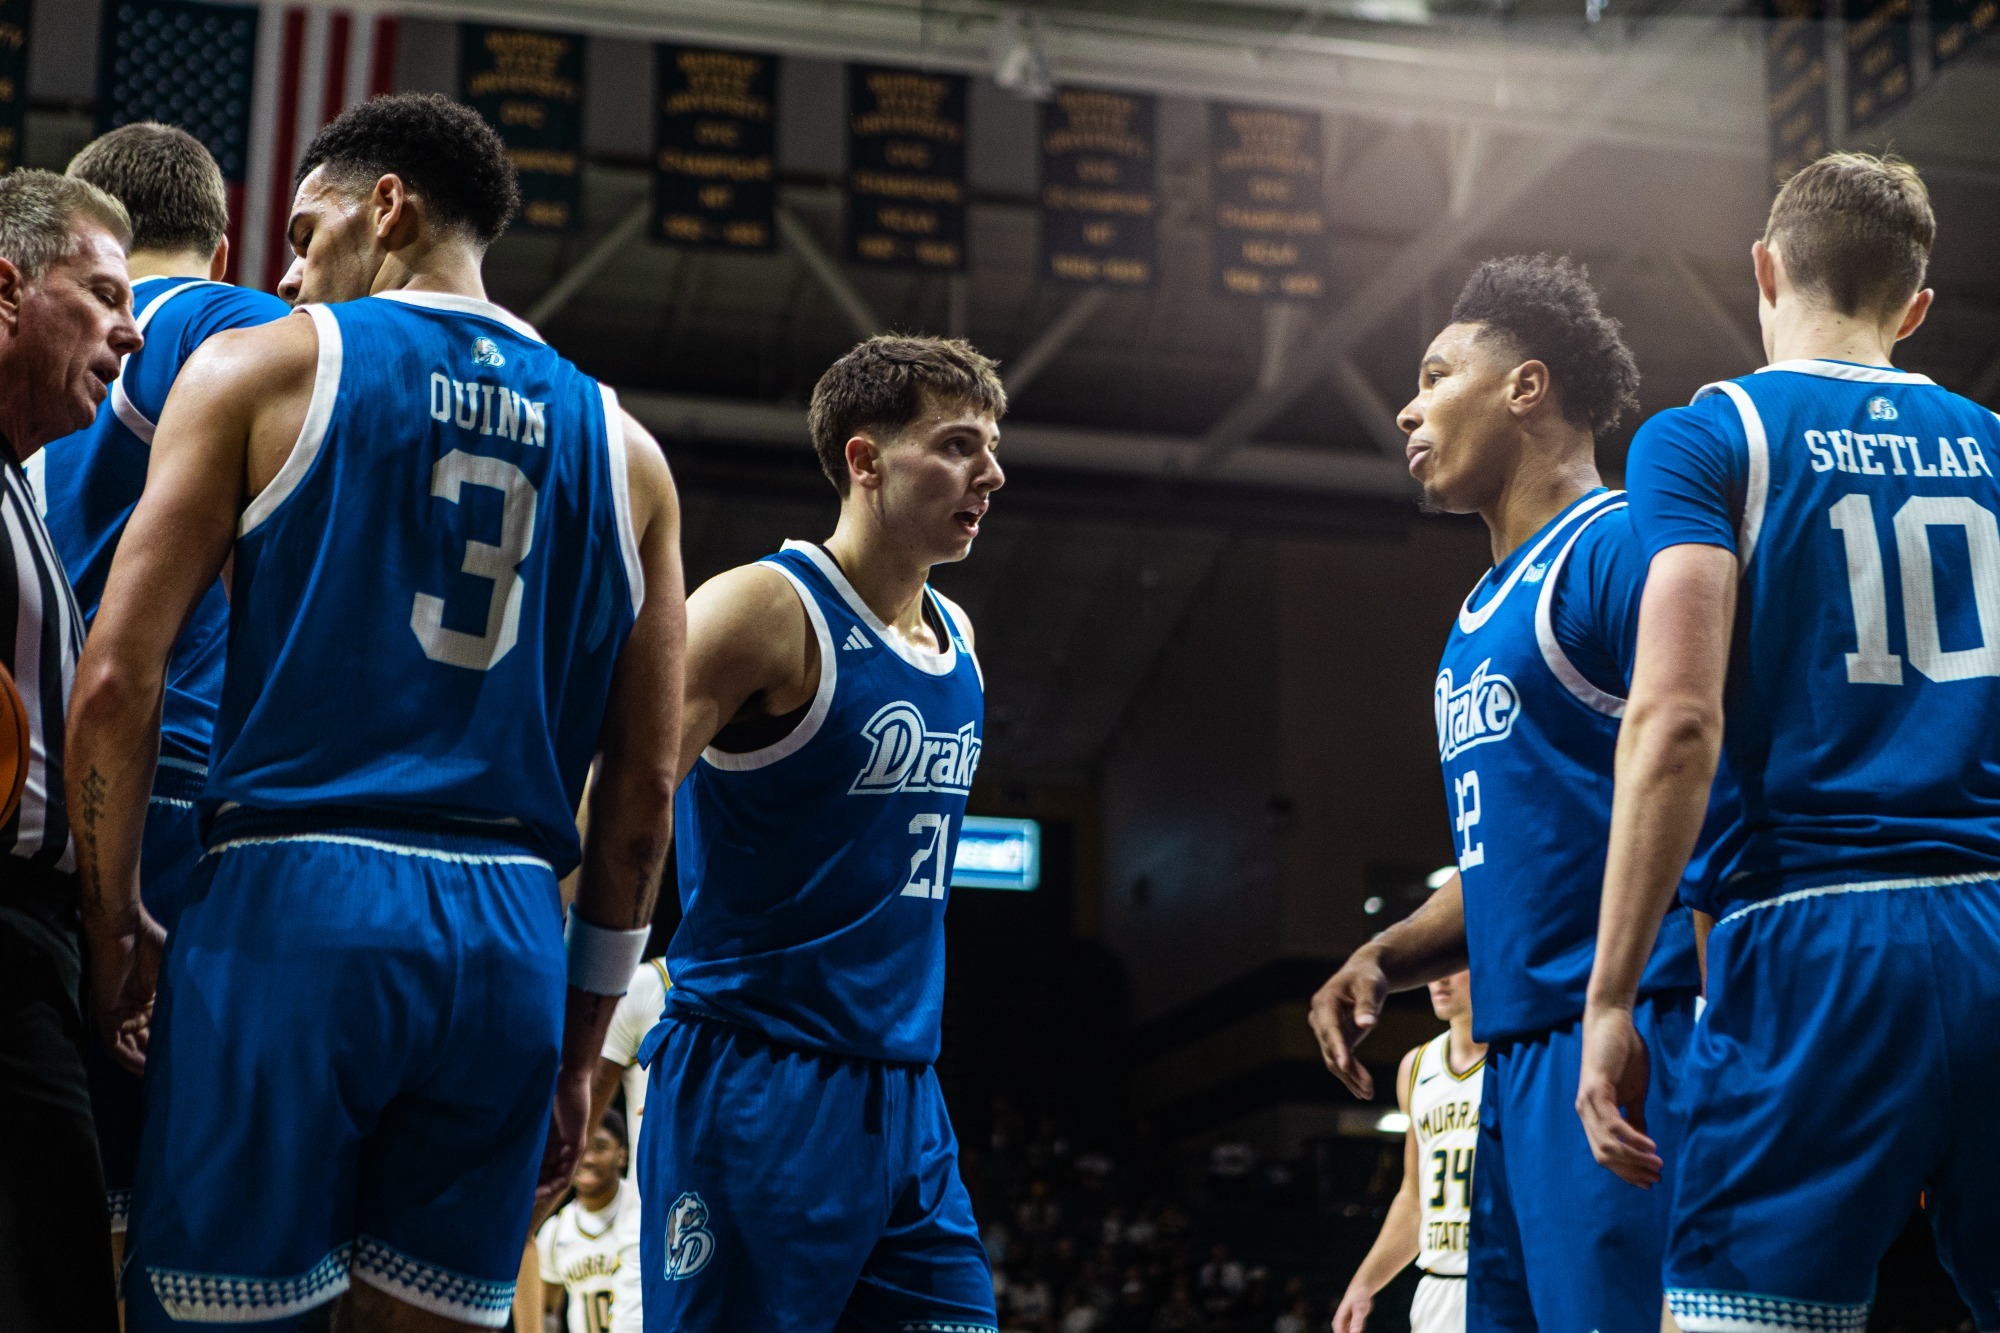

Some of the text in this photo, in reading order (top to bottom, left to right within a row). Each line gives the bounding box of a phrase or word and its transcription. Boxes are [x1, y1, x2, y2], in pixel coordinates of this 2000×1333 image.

[430, 372, 546, 448] QUINN
[1804, 429, 1993, 477] SHETLAR
[410, 448, 538, 671] 3
[1829, 494, 2000, 685] 10
[1435, 658, 1521, 763] Drake
[900, 813, 950, 900] 21
[1454, 770, 1484, 872] 12
[1428, 1148, 1474, 1210] 34
